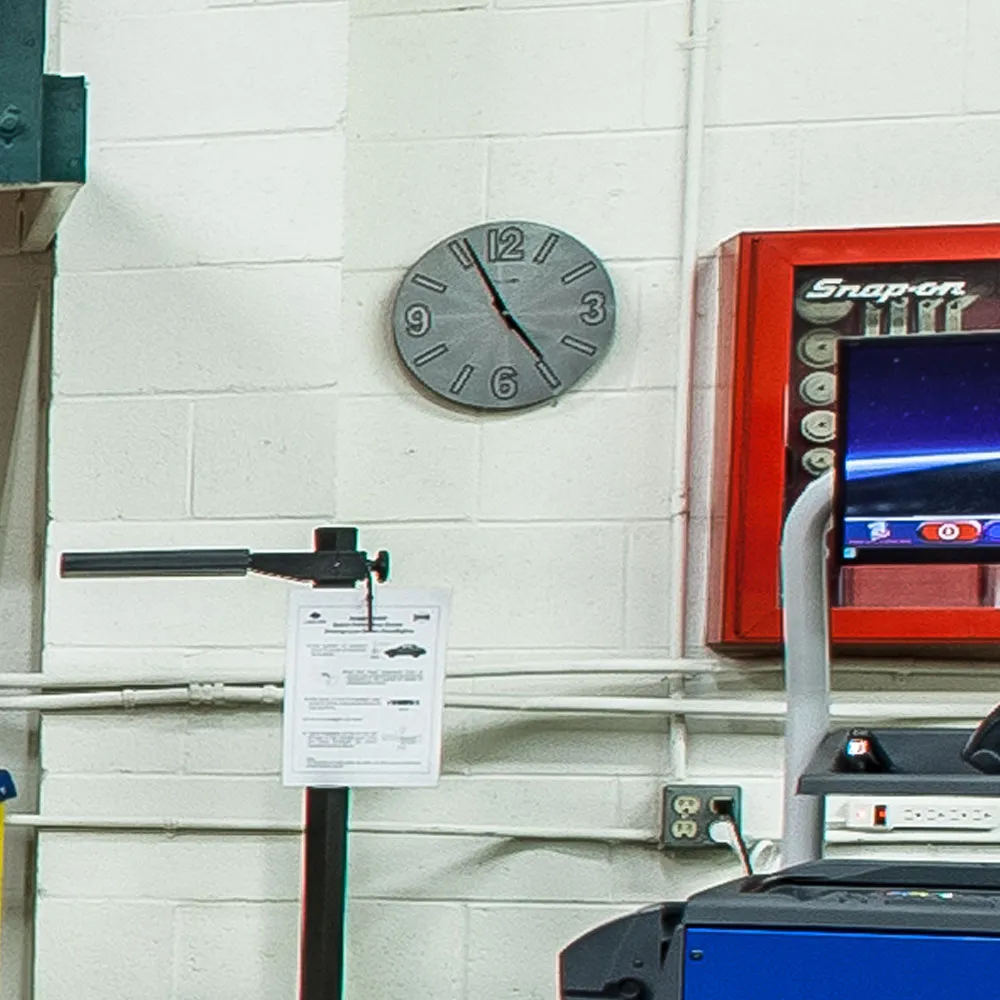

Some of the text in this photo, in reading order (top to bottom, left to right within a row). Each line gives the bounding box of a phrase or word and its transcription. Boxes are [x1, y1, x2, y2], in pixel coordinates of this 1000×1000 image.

[487, 226, 525, 262] 12
[805, 277, 967, 304] Snap-on
[405, 302, 431, 337] 9
[580, 291, 607, 326] 3
[491, 366, 519, 400] 6
